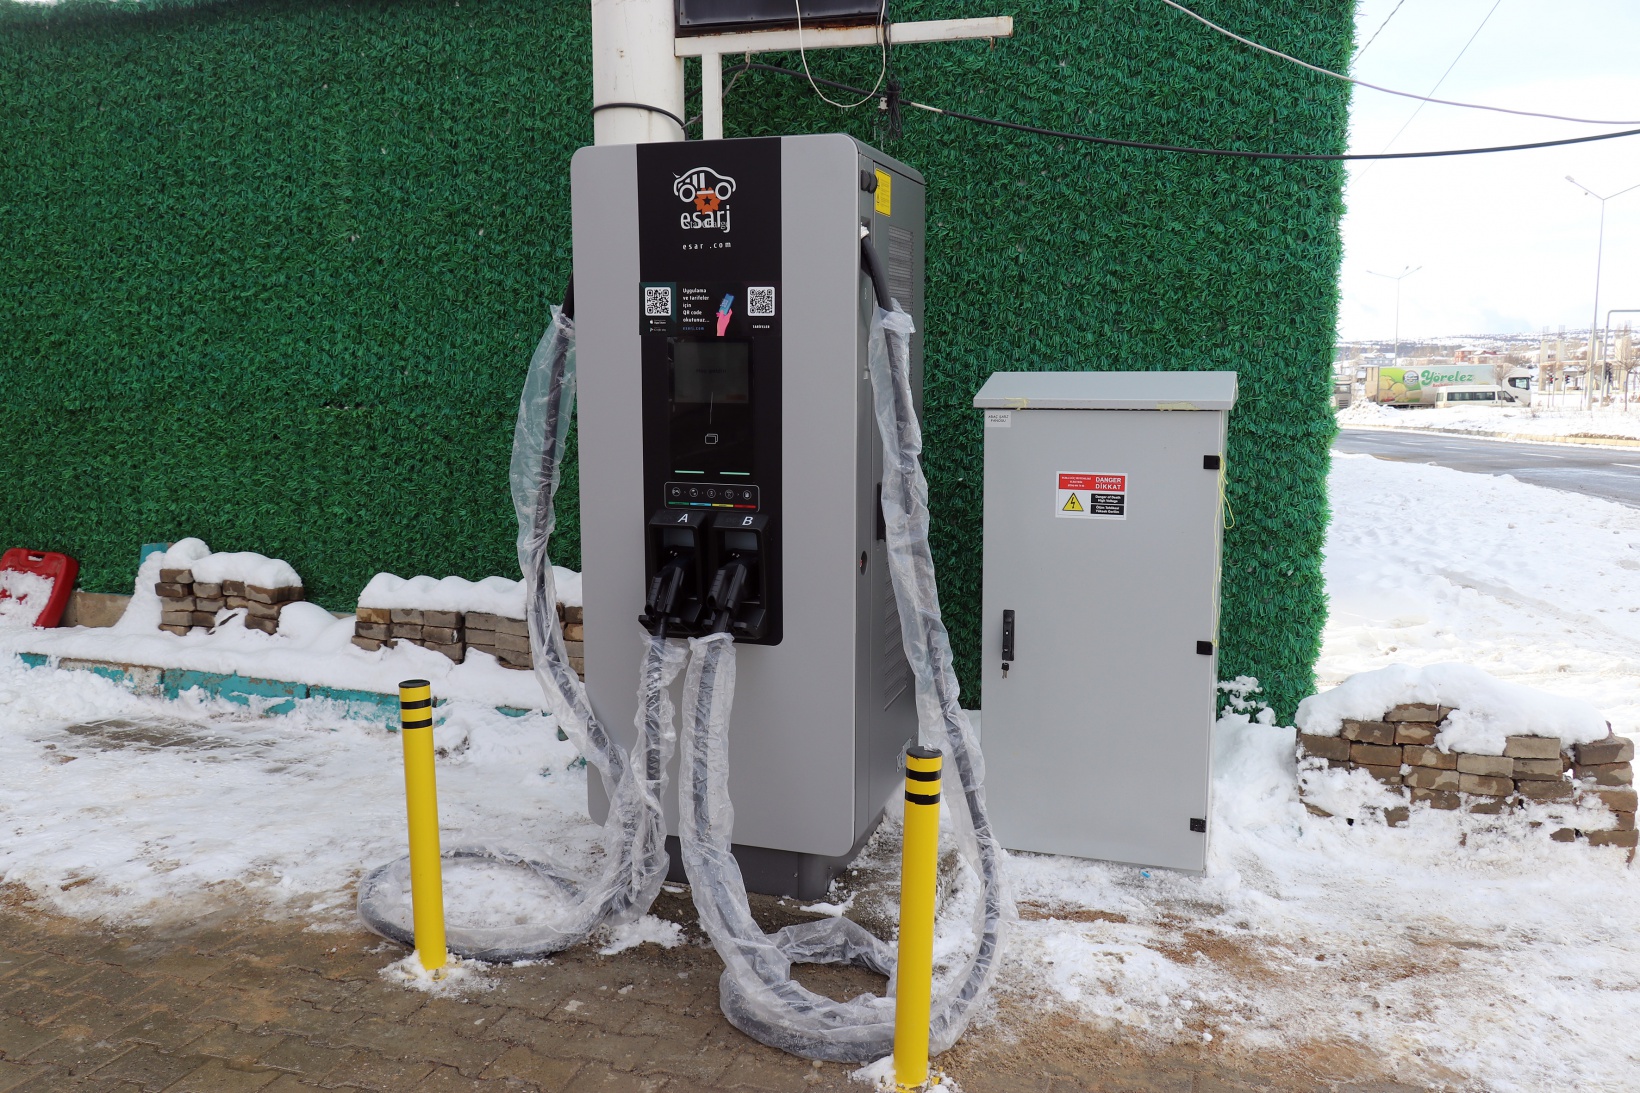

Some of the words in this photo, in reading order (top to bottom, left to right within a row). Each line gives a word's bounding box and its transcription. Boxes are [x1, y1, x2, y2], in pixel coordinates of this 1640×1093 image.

[680, 204, 731, 233] esarj
[682, 287, 707, 295] Uygulama
[1420, 369, 1473, 386] Yörelez
[677, 513, 689, 523] A
[742, 516, 754, 526] B
